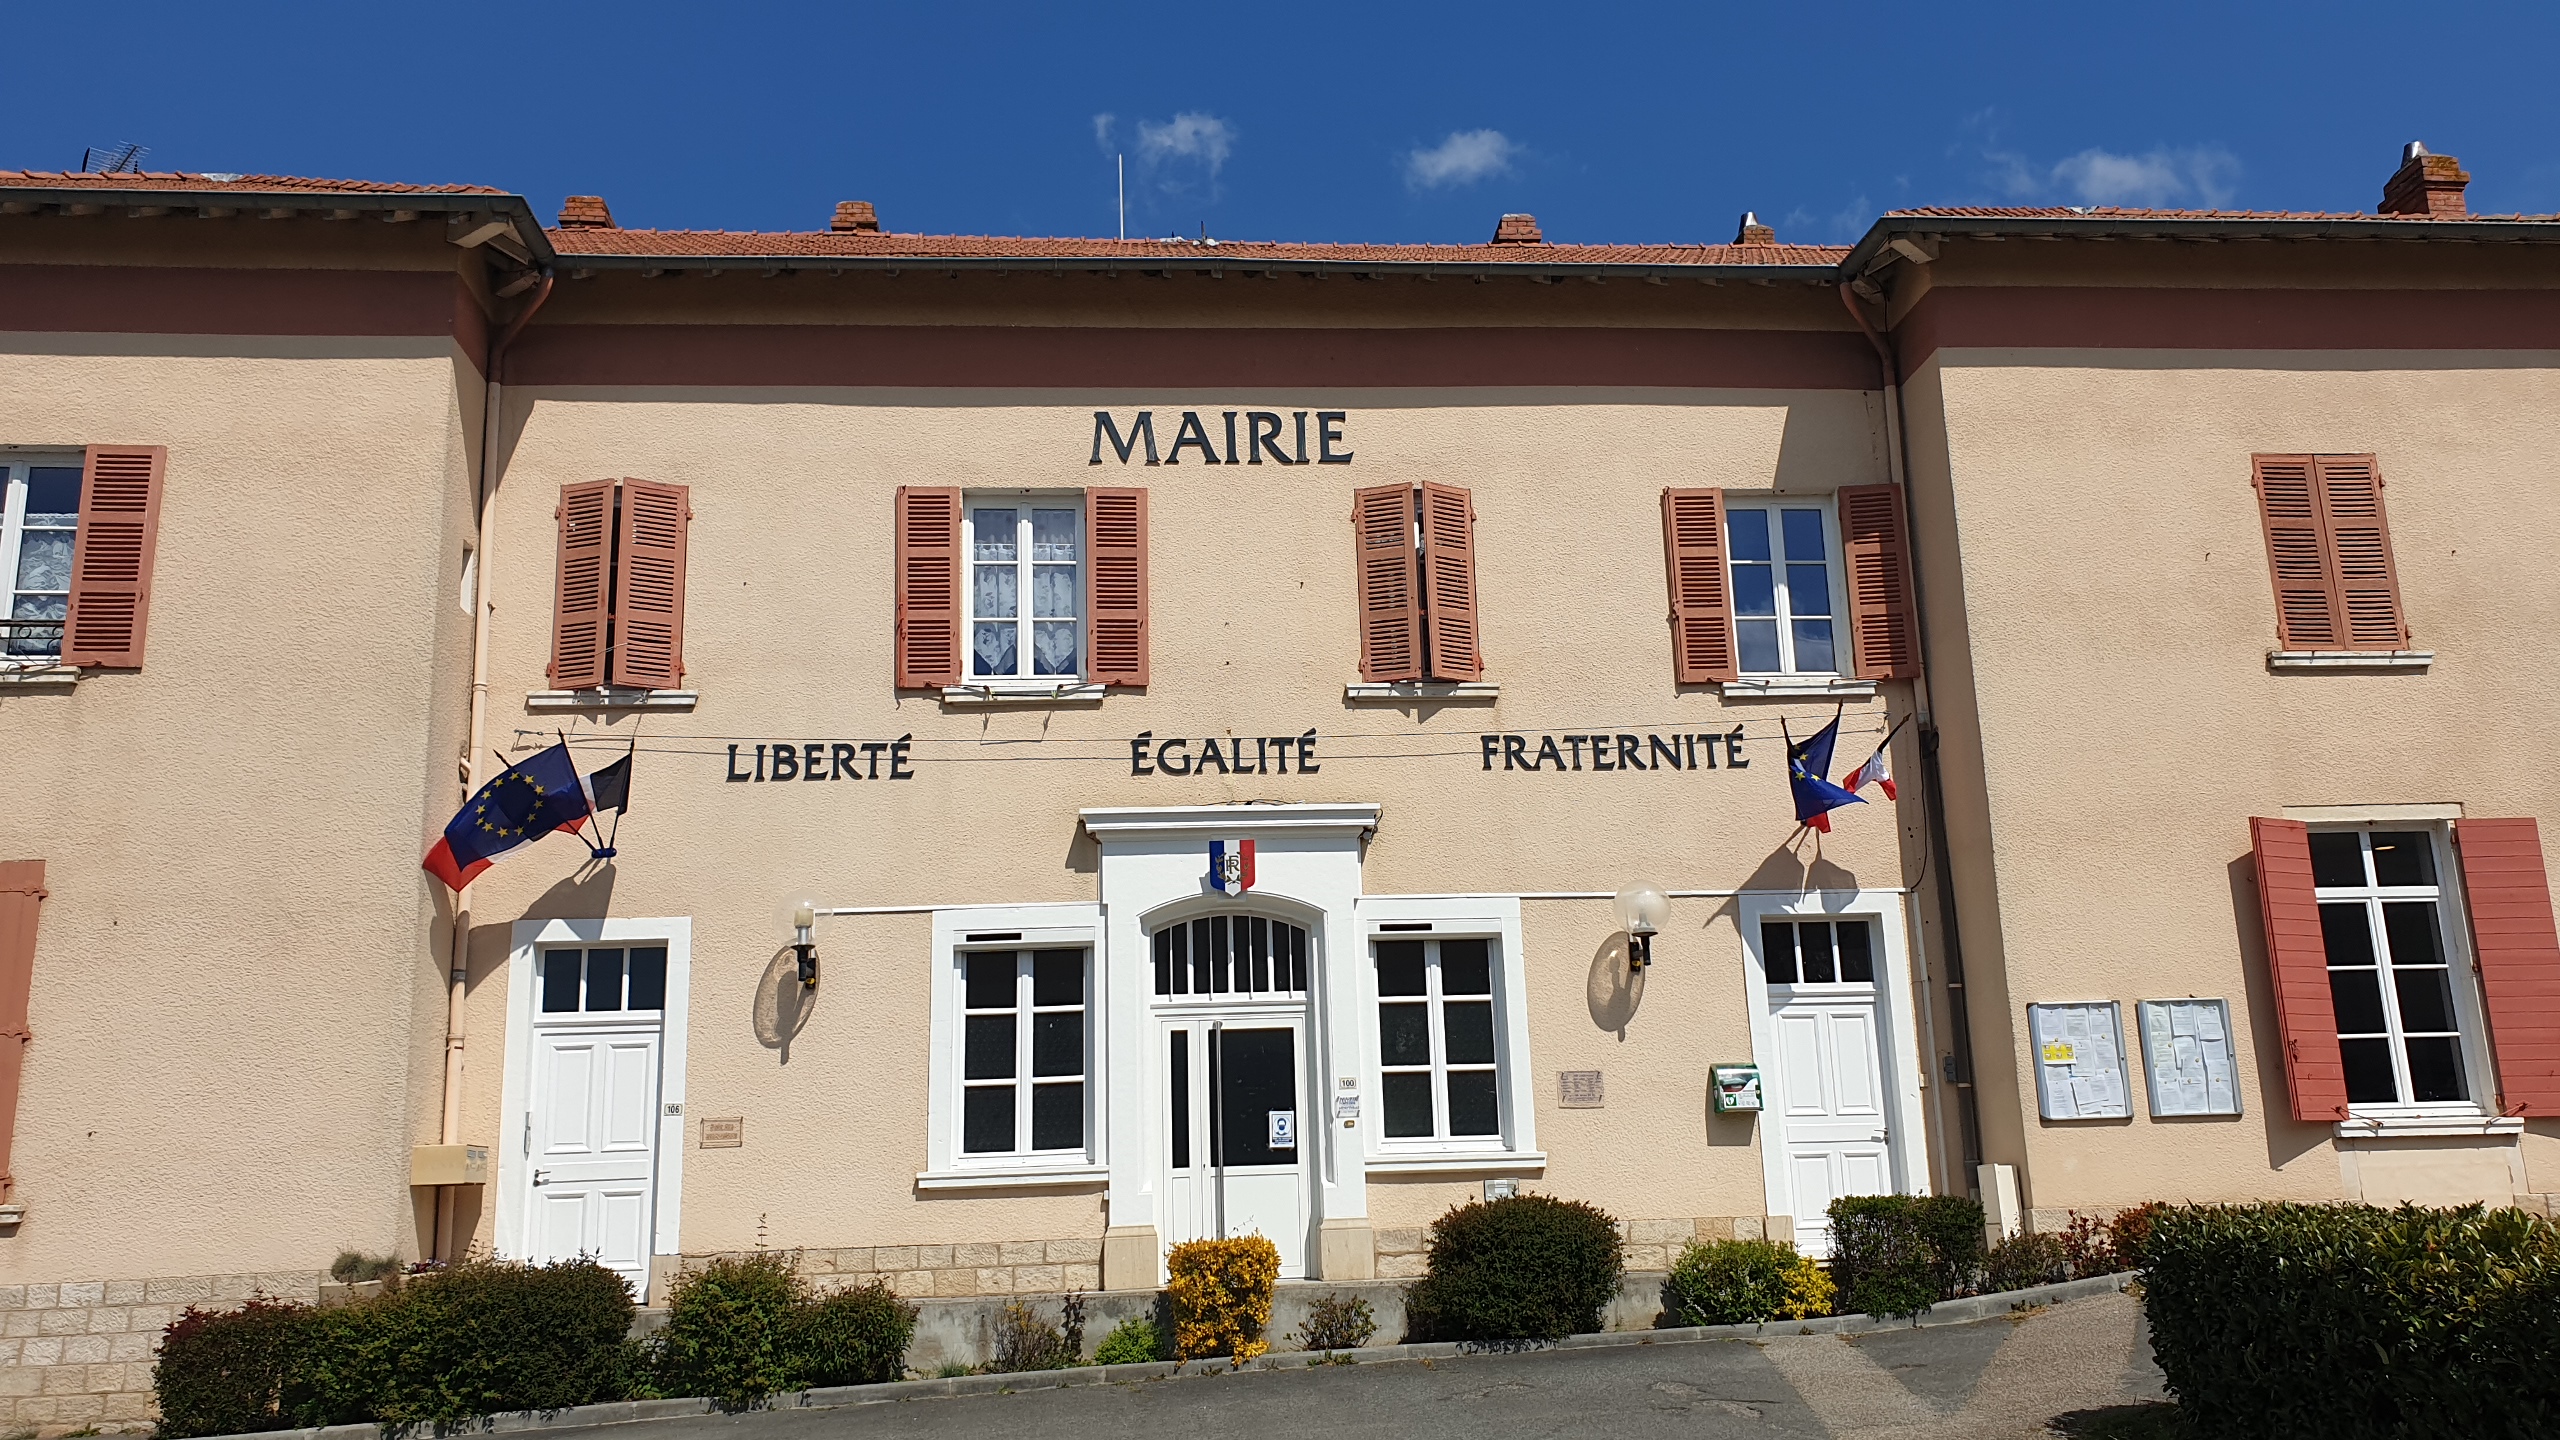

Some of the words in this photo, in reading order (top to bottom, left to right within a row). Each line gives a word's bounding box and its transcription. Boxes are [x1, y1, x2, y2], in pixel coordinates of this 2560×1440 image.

[1088, 411, 1354, 465] MAIRIE
[726, 732, 915, 782] LIBERTÉ
[1131, 727, 1320, 777] ÉGALITÉ
[1480, 724, 1750, 771] FRATERNITÉ
[1341, 1079, 1354, 1087] 100
